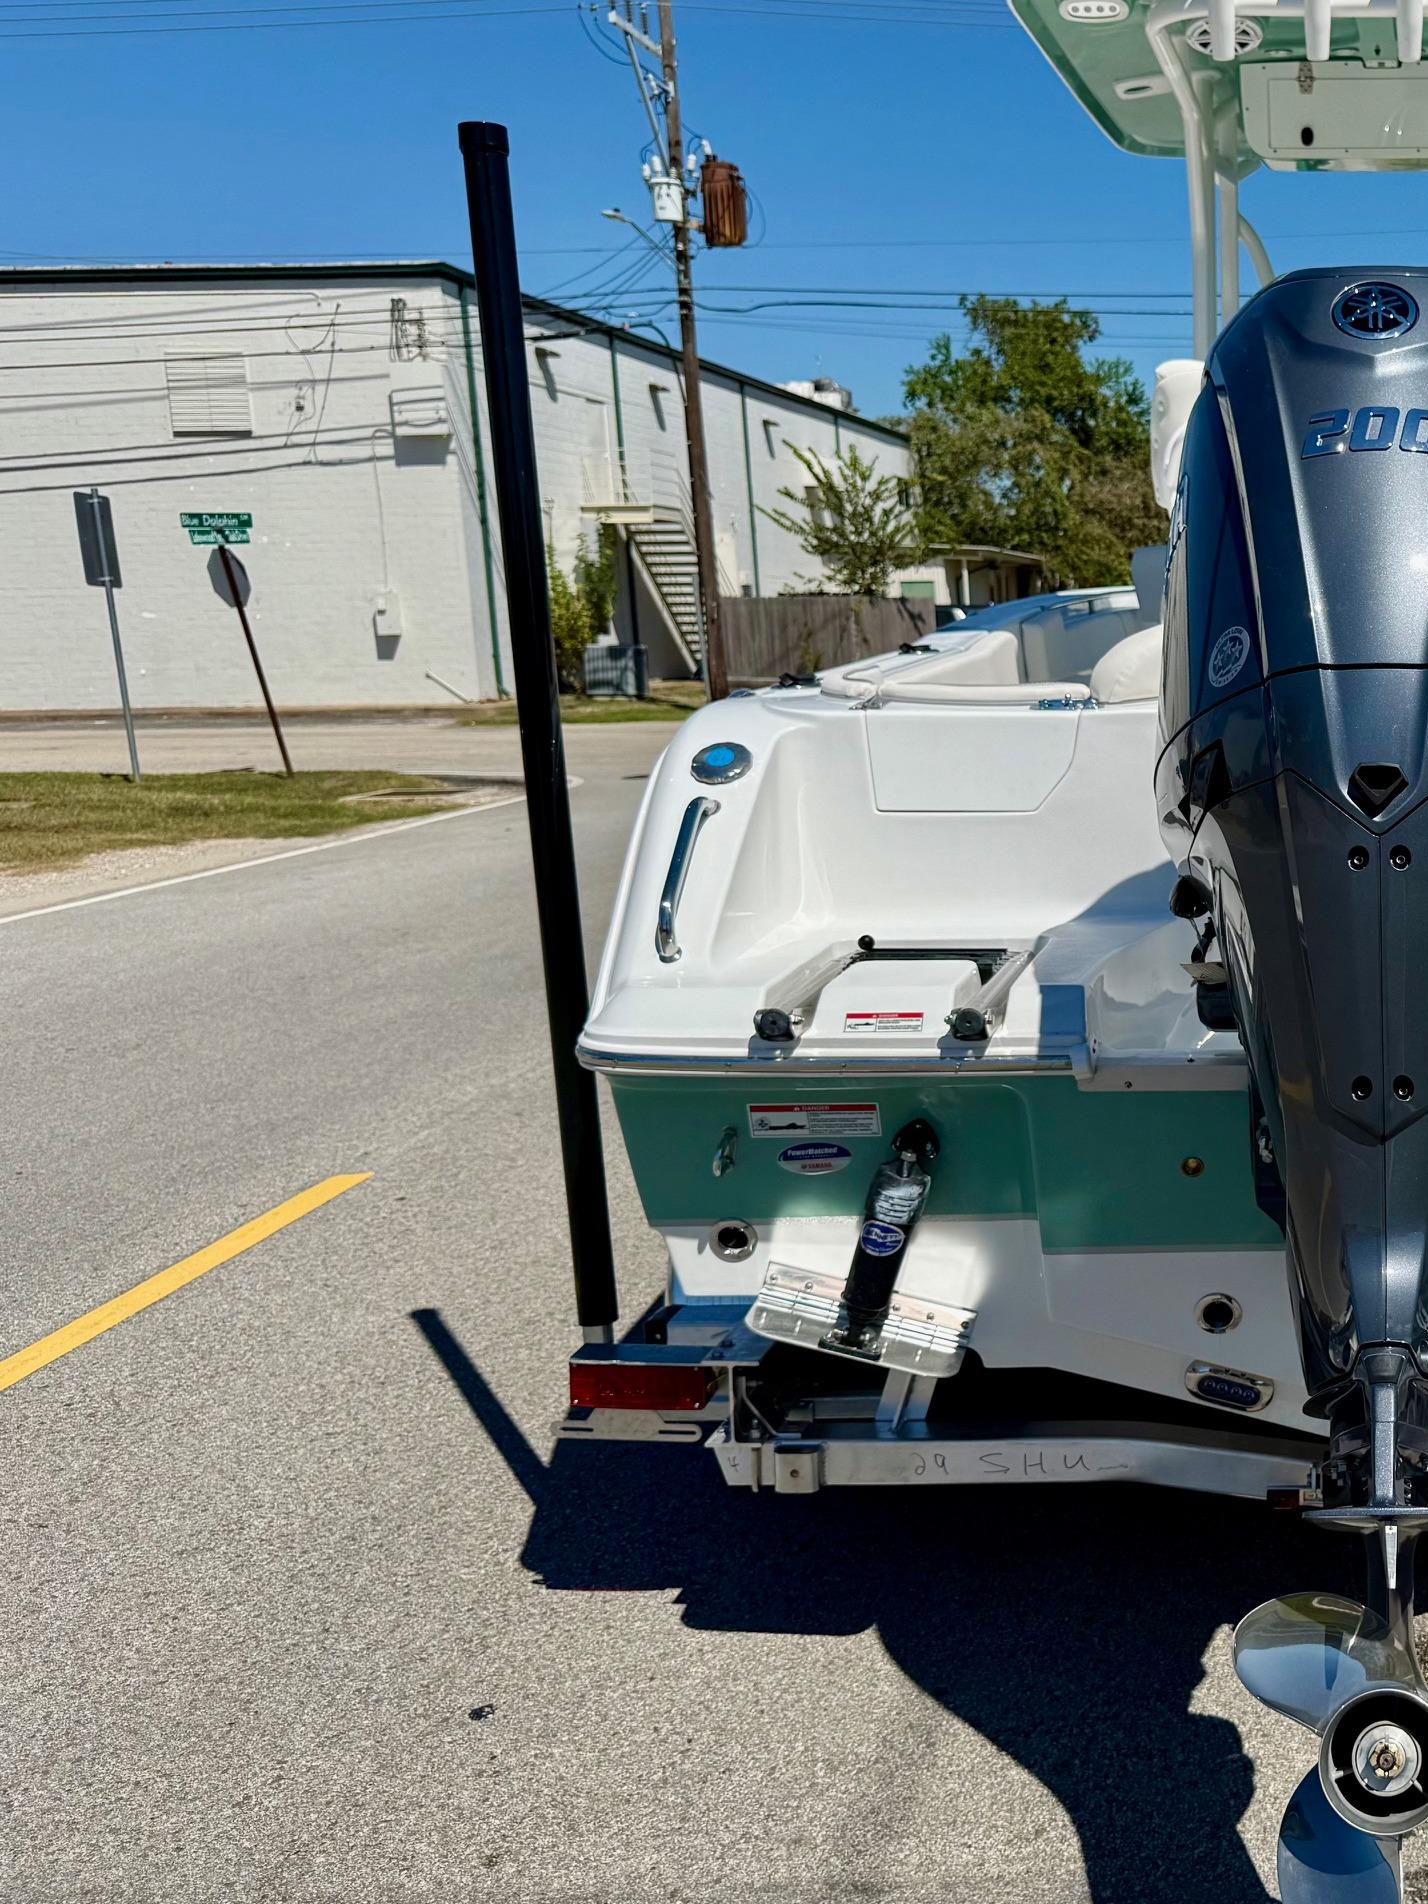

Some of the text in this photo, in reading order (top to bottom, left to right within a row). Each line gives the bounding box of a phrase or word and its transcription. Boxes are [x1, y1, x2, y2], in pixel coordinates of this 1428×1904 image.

[181, 514, 200, 526] Blue
[202, 514, 239, 527] Dolphin
[787, 1146, 838, 1157] PowerMatched
